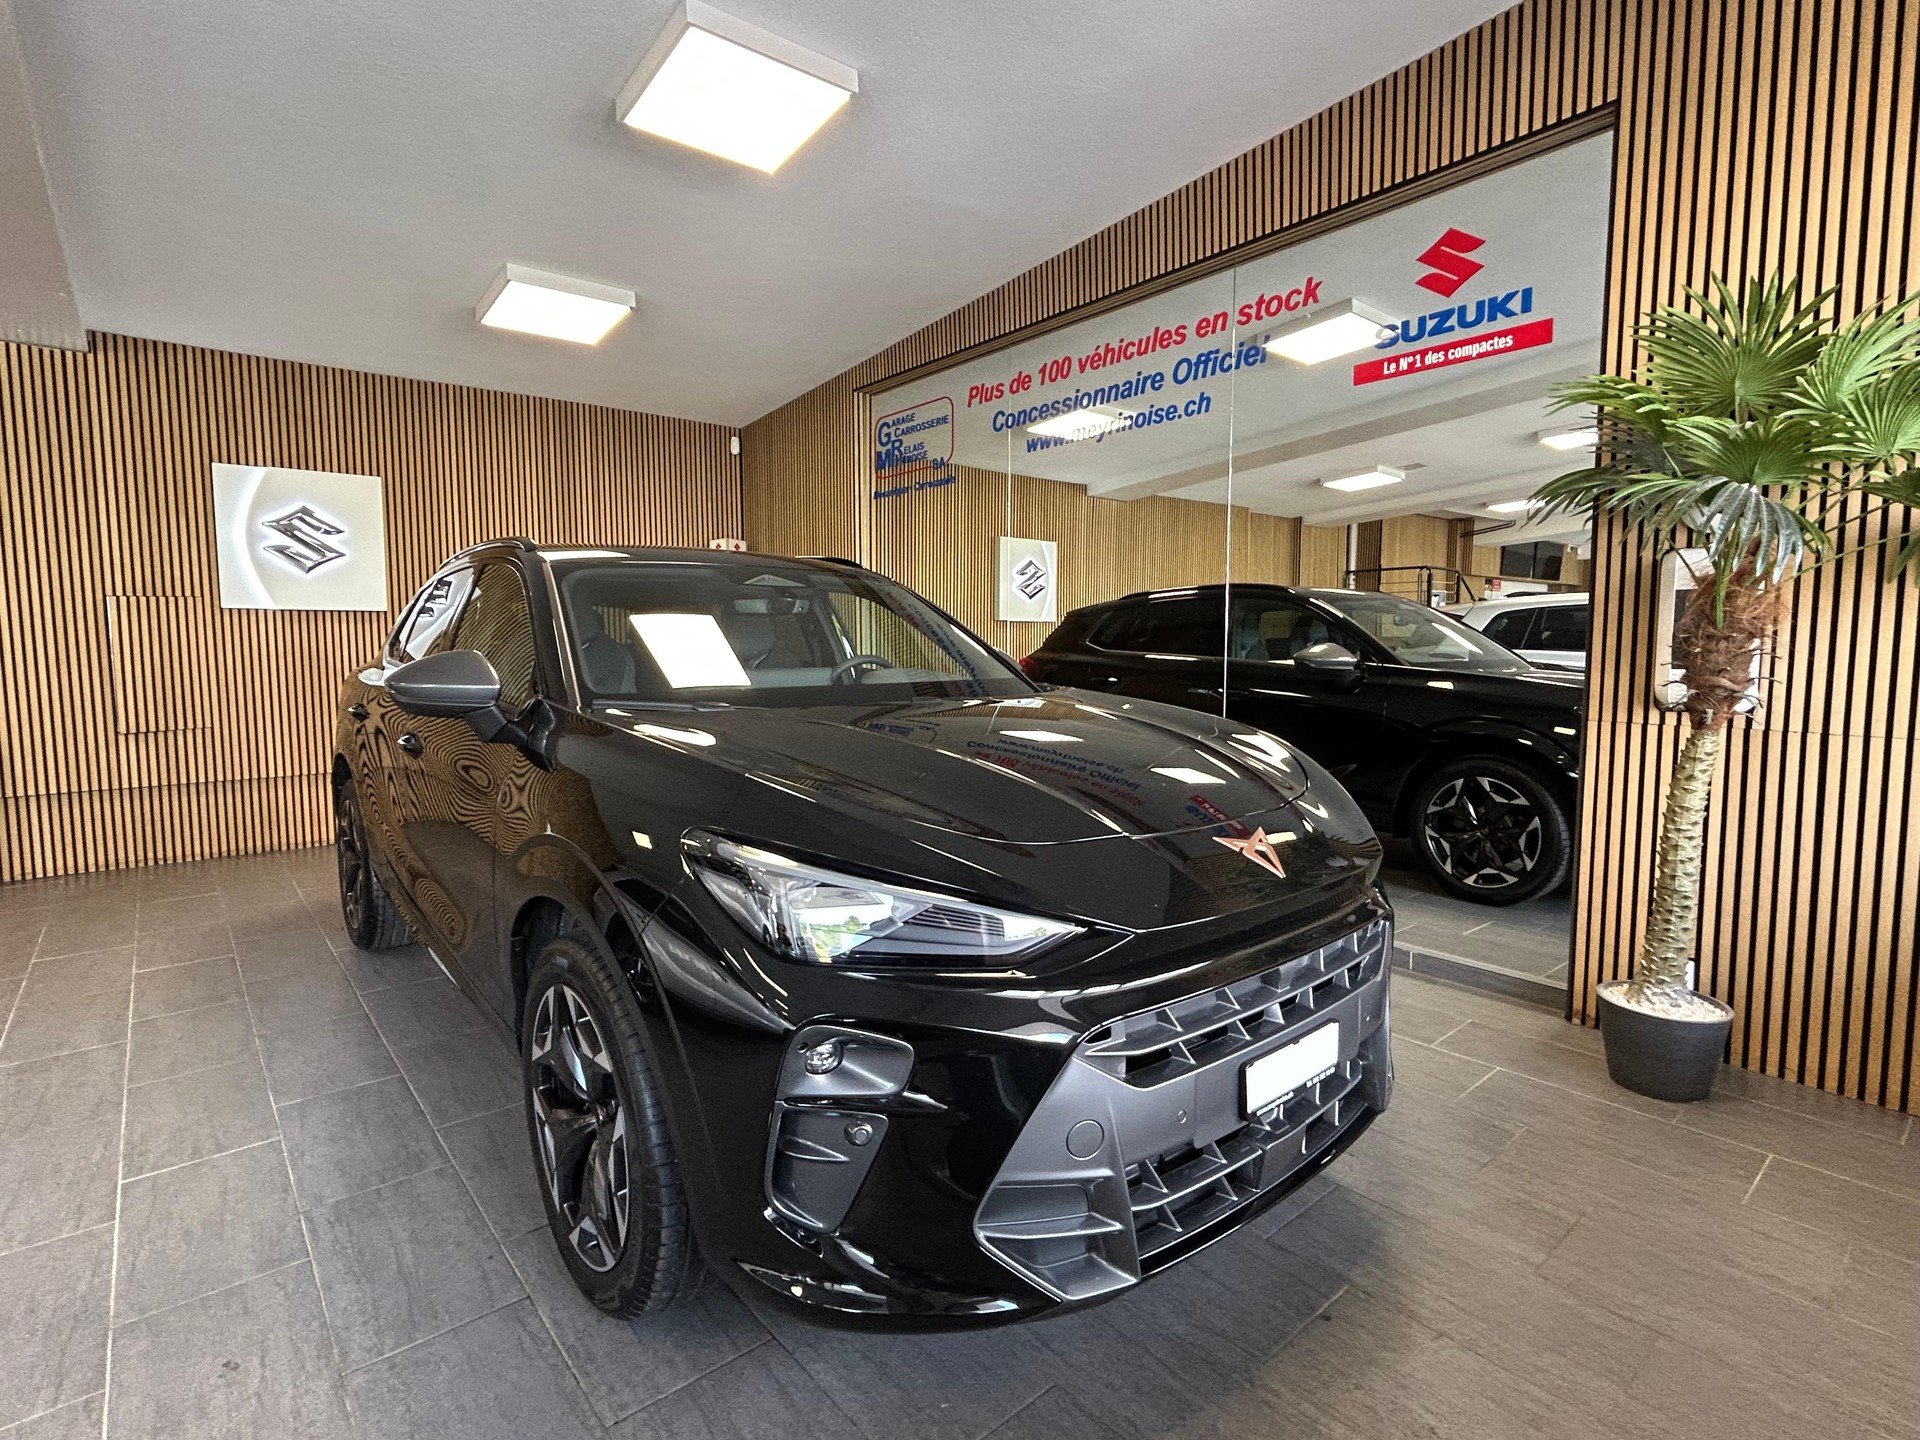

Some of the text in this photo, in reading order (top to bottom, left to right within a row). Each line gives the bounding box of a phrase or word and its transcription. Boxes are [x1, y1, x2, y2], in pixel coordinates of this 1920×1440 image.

[967, 276, 1323, 408] Plus de 100 véhicules en stock
[1374, 286, 1533, 350] SUZUKI
[992, 335, 1271, 433] Concessionnaire Officiel
[1383, 361, 1396, 375] Le
[1424, 347, 1445, 366] des
[1447, 334, 1514, 362] compactes
[894, 414, 950, 438] CARROSSERIE
[1026, 392, 1211, 453] www.meyrinoise.ch
